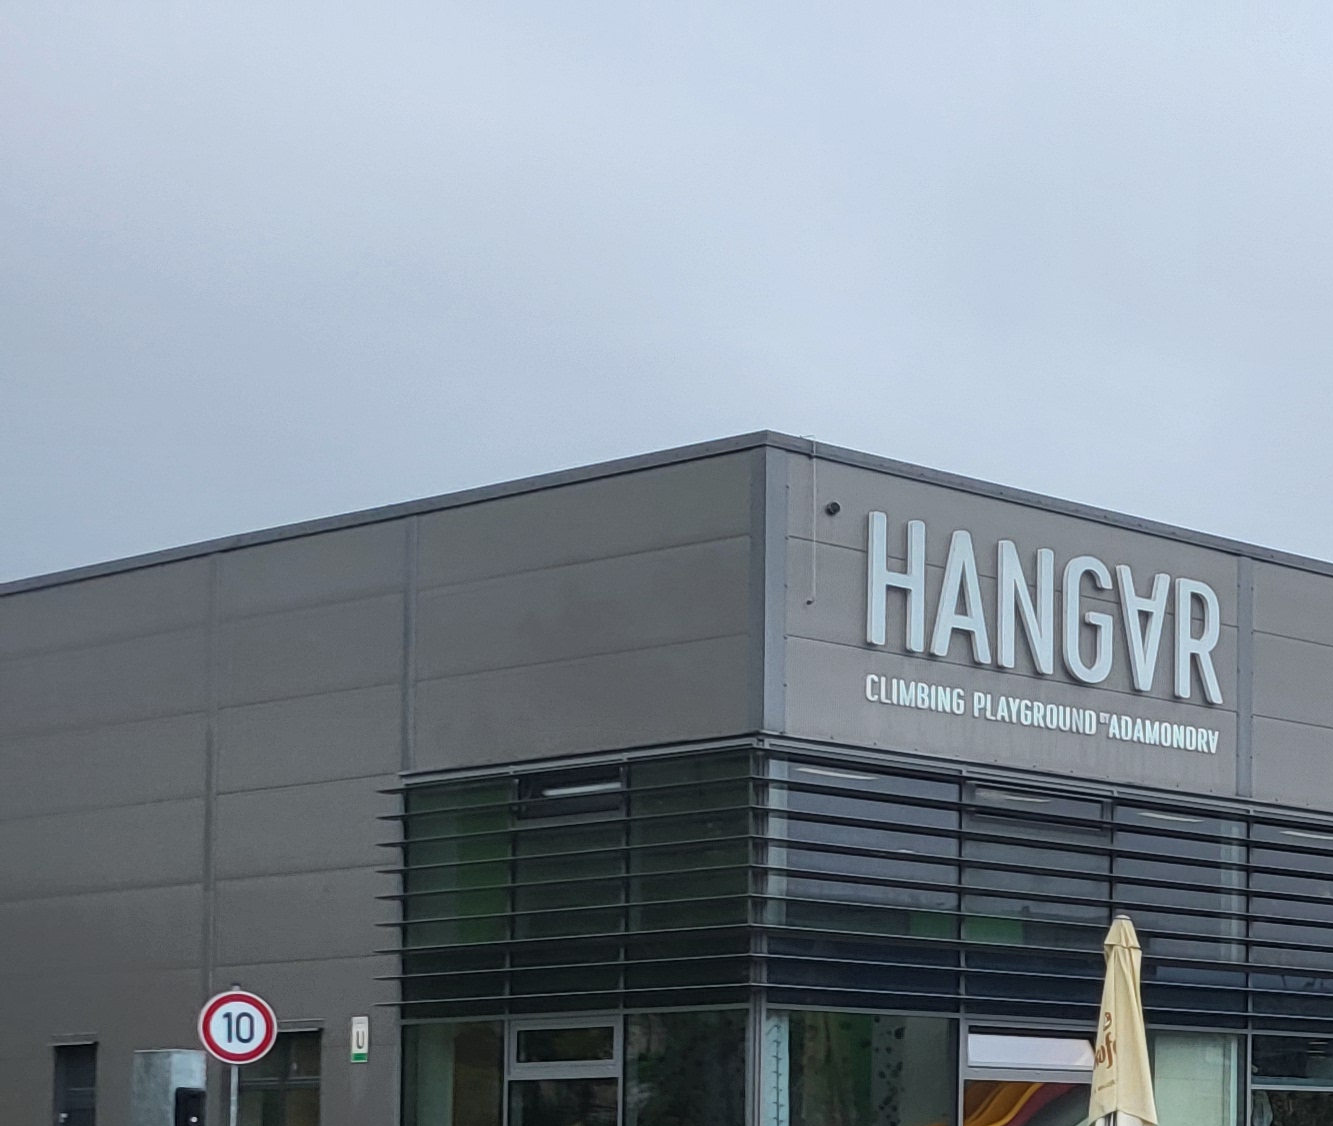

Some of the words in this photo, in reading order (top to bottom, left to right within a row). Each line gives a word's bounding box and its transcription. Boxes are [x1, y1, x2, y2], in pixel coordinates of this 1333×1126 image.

[865, 674, 965, 715] CLIMBING
[973, 692, 1097, 735] PLAYGROUND
[222, 1011, 255, 1044] 10
